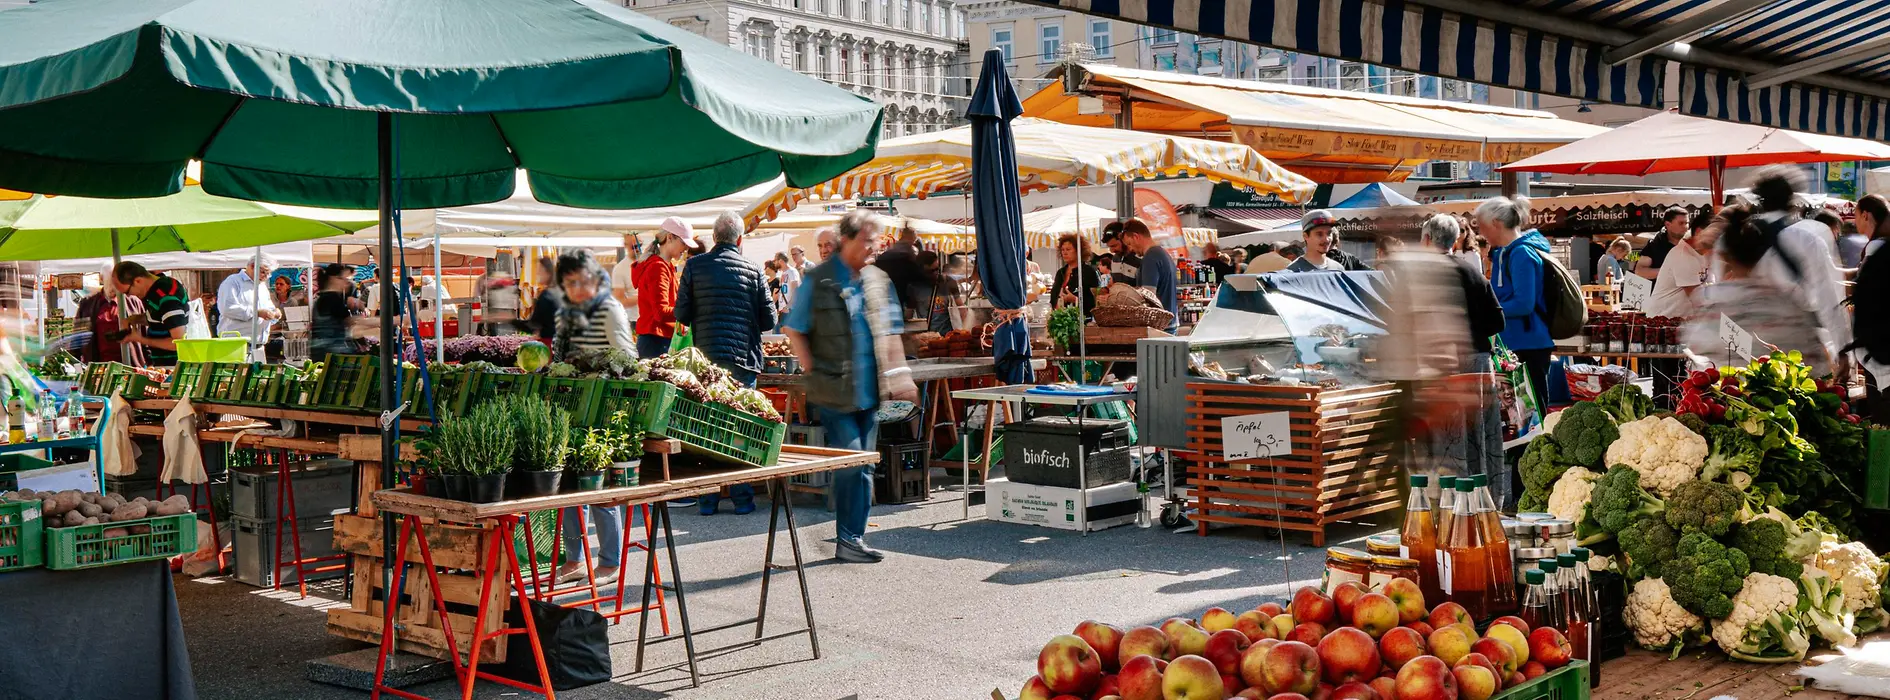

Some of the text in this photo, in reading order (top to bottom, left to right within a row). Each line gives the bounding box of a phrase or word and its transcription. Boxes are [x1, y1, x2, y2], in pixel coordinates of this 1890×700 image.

[1296, 133, 1314, 146] Wien
[1381, 139, 1397, 151] Wien
[1576, 210, 1629, 221] Salzfleisch
[1235, 421, 1262, 434] Äpfel
[1023, 447, 1070, 468] biofisch
